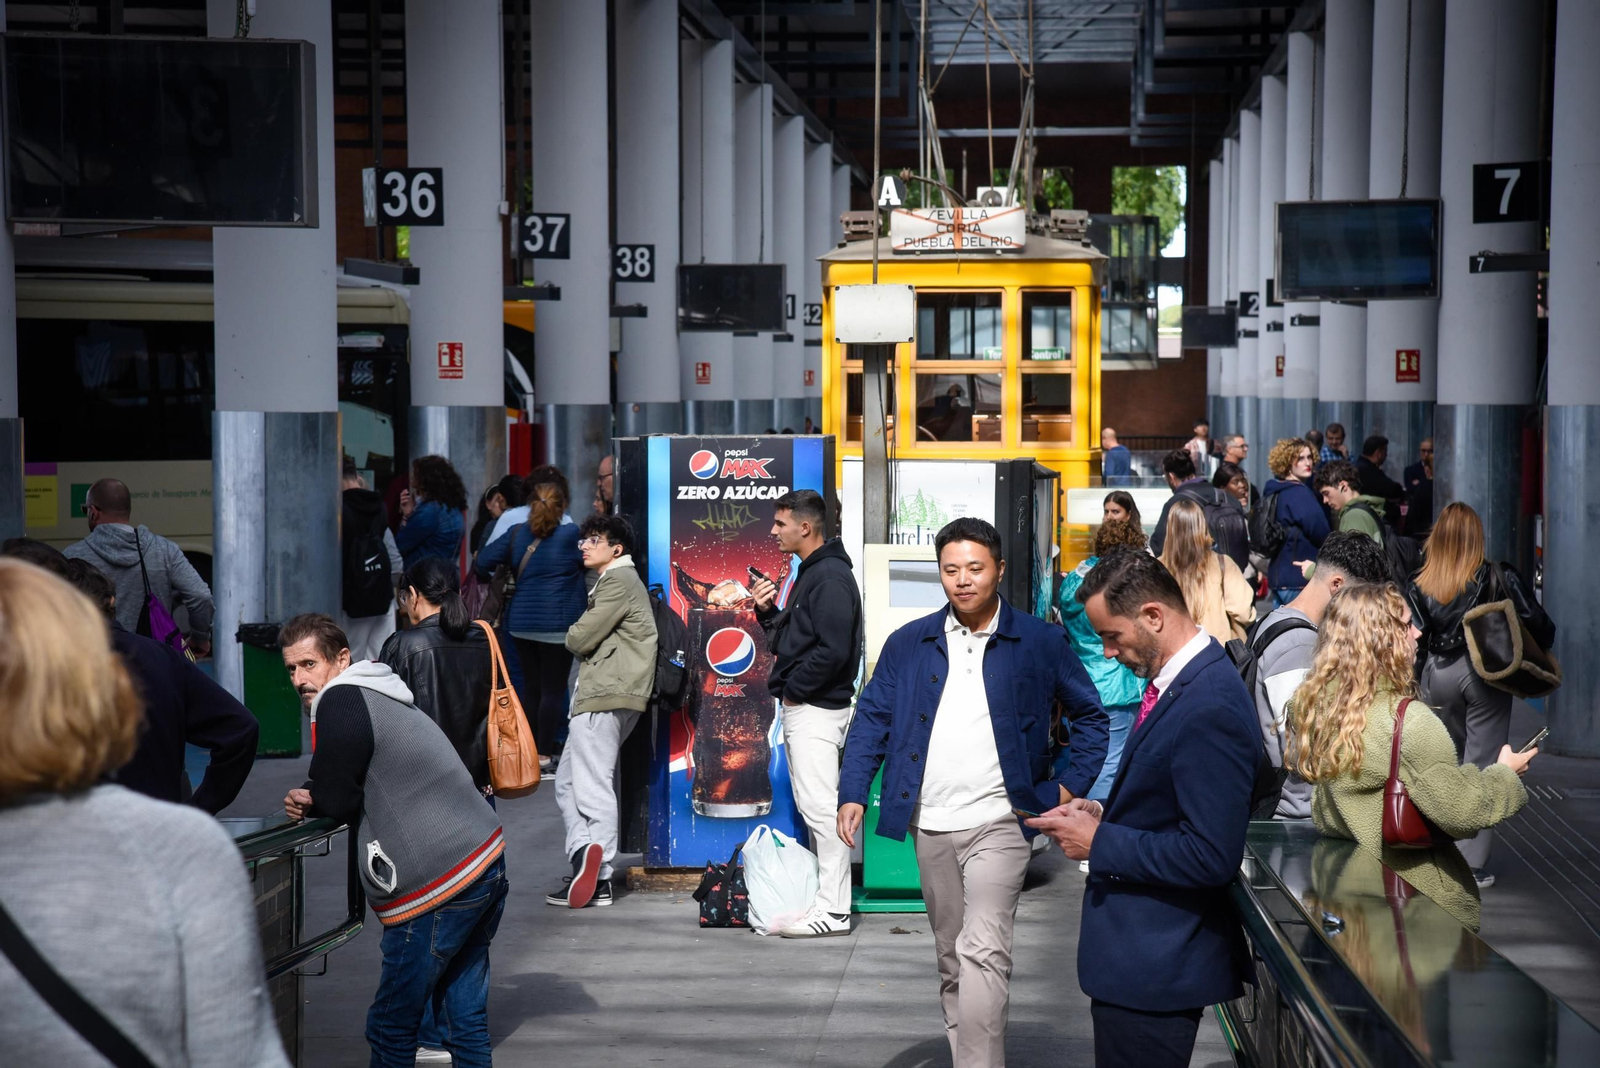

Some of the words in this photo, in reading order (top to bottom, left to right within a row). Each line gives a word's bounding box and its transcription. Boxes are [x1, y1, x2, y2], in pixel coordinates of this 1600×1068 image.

[382, 171, 436, 218] 36
[878, 176, 901, 206] A
[1494, 168, 1520, 215] 7
[925, 209, 989, 220] SEVILLA
[523, 215, 566, 252] 37
[936, 223, 981, 234] CORIA
[904, 237, 955, 248] PUEBLA
[961, 236, 985, 247] DEL
[990, 235, 1013, 247] RIO
[615, 247, 651, 278] 38
[1477, 257, 1485, 272] 7
[1248, 294, 1259, 315] 2
[804, 305, 821, 324] 42
[724, 448, 749, 458] pepsi
[719, 458, 775, 480] MAX
[677, 485, 720, 500] ZERO
[714, 684, 747, 698] MAX
